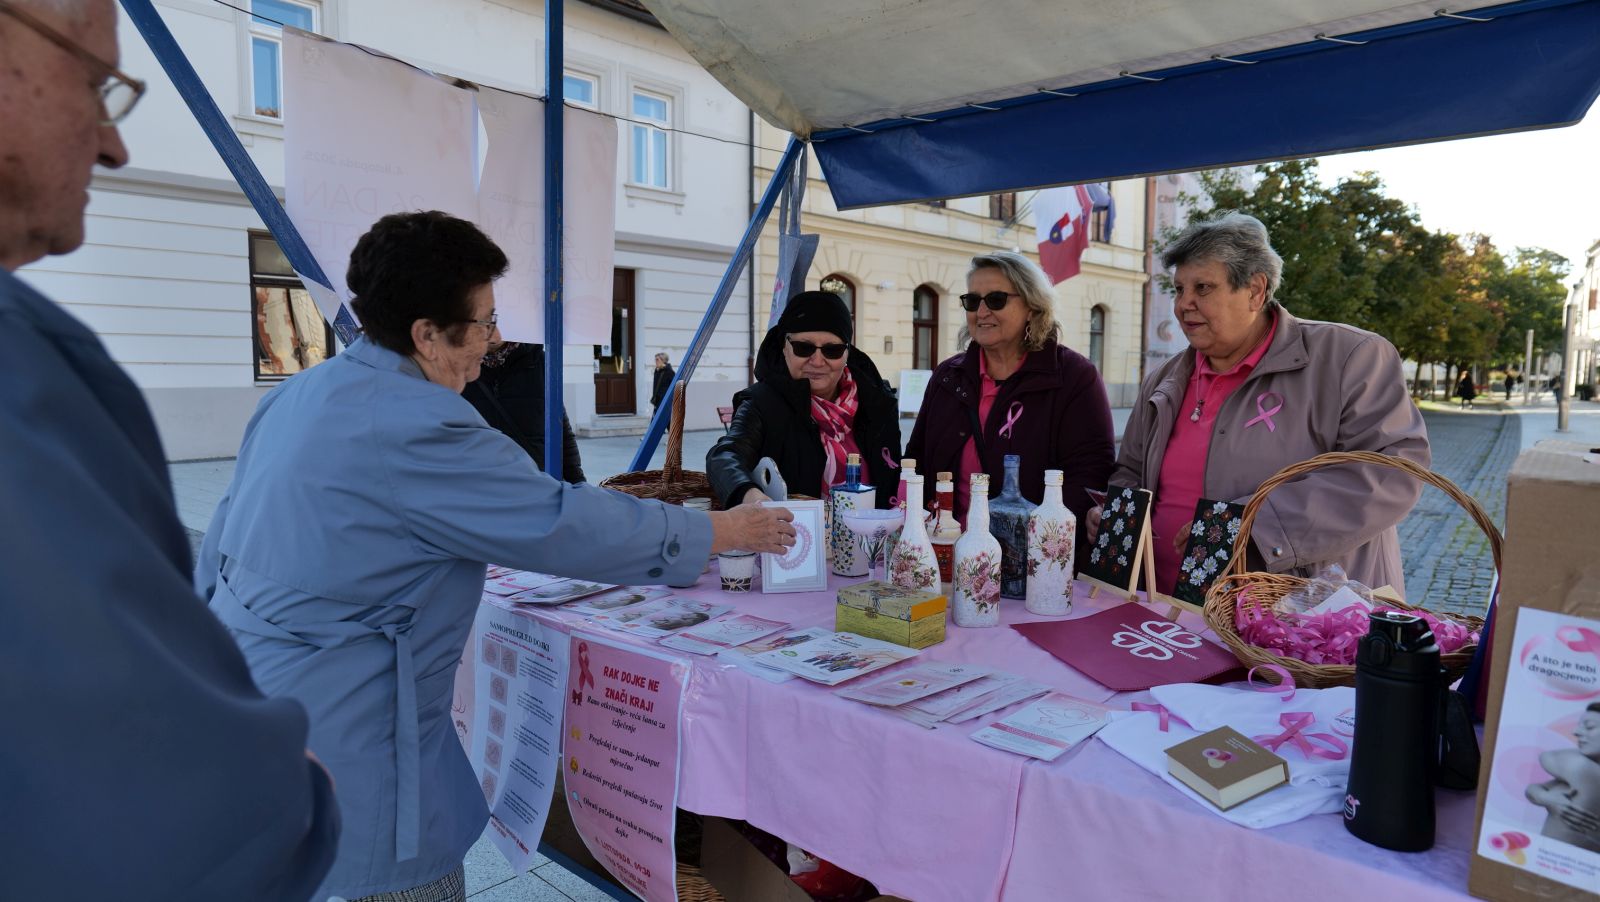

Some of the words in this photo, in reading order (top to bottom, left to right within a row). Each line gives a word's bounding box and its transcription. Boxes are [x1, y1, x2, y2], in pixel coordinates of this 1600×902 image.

[489, 620, 533, 643] SAMOPREGLED
[533, 636, 550, 652] DOJKI
[1528, 663, 1597, 685] dragocjeno?
[1532, 653, 1540, 662] A
[1543, 656, 1559, 666] što
[1561, 660, 1572, 669] je
[1575, 662, 1597, 674] tebi
[603, 665, 620, 681] RAK
[620, 671, 647, 689] DOJKE
[648, 679, 660, 693] NE
[605, 687, 628, 705] ZNAČI
[658, 722, 666, 730] za
[588, 733, 612, 750] Pregledaj
[635, 751, 661, 768] jedanput
[609, 756, 634, 772] mjesečno
[582, 767, 602, 784] Redoviti
[602, 777, 623, 793] pregledi
[623, 788, 649, 805] spašavaju
[615, 815, 622, 823] na
[615, 826, 629, 839] dojke
